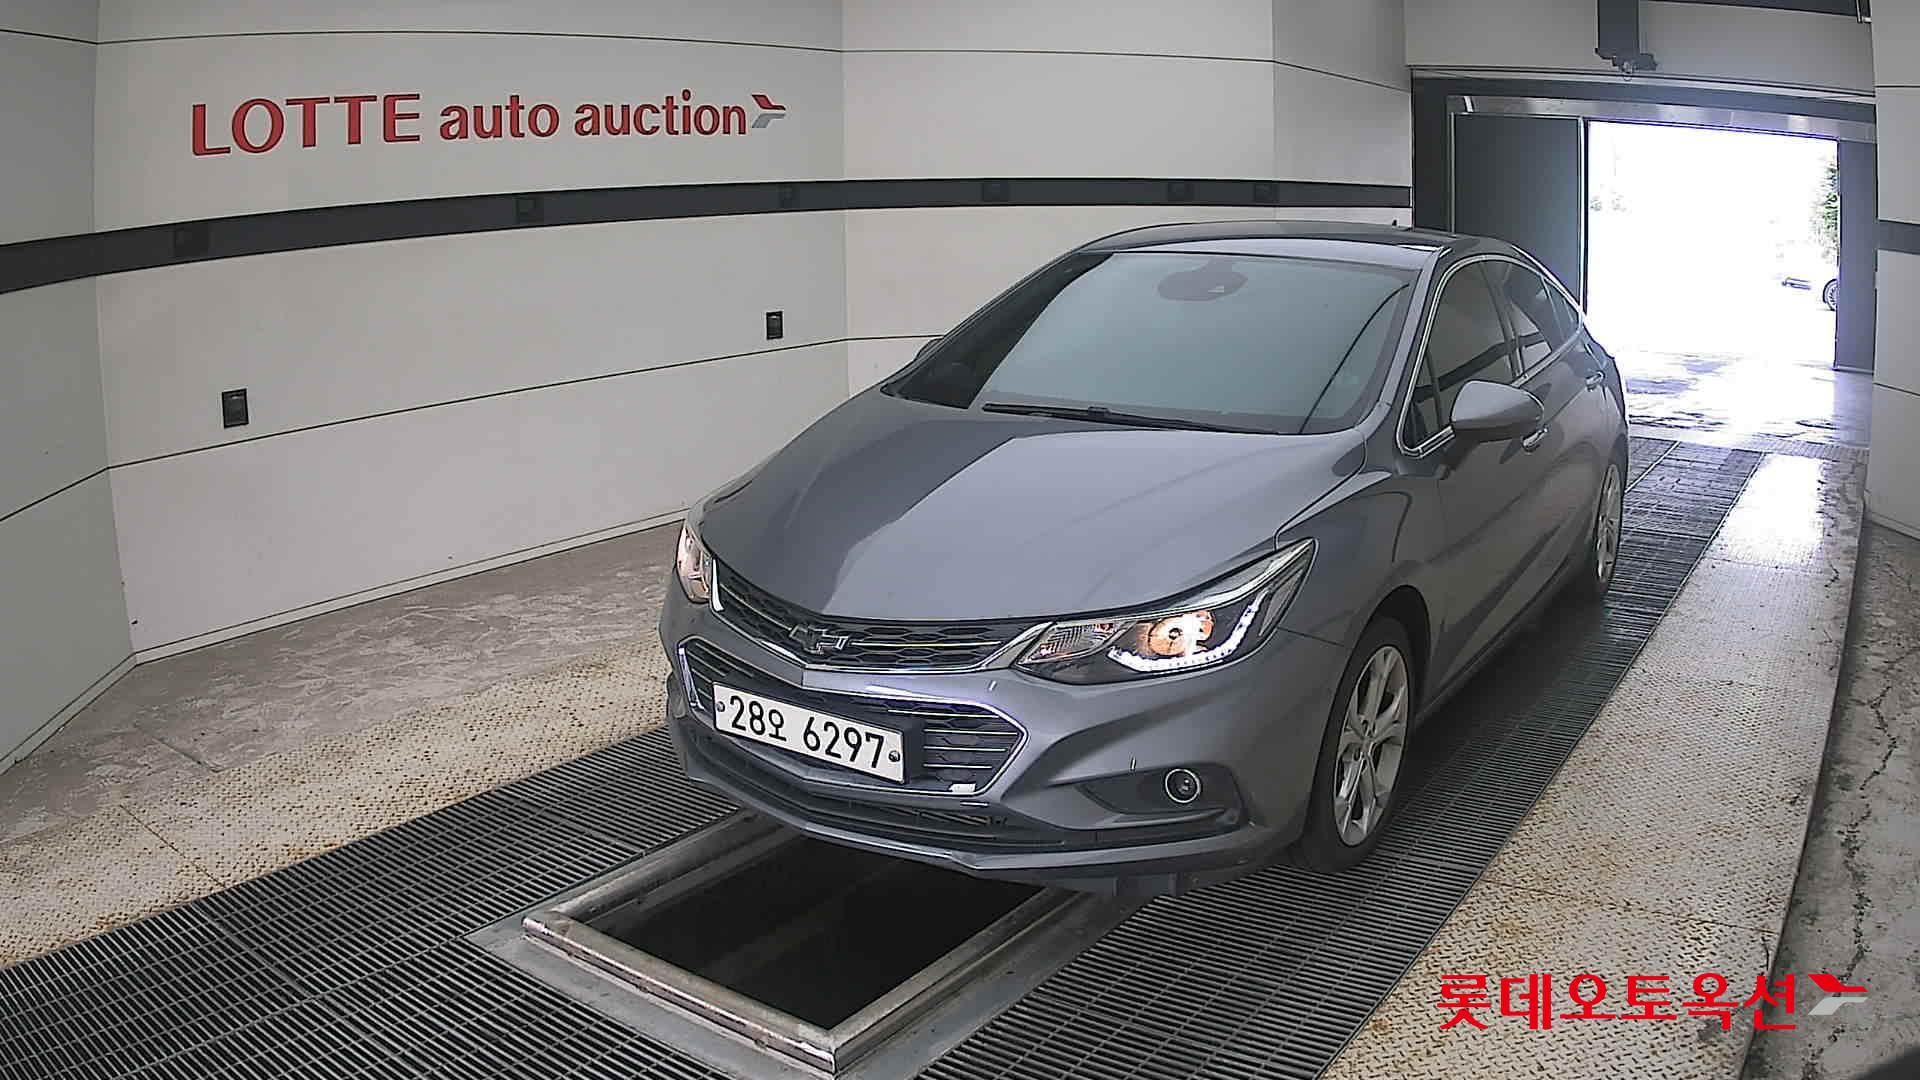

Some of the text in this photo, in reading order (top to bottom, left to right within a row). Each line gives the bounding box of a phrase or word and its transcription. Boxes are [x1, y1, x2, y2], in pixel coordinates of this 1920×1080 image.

[191, 88, 747, 157] LOTTE auto auction
[729, 695, 884, 769] 28오 6297
